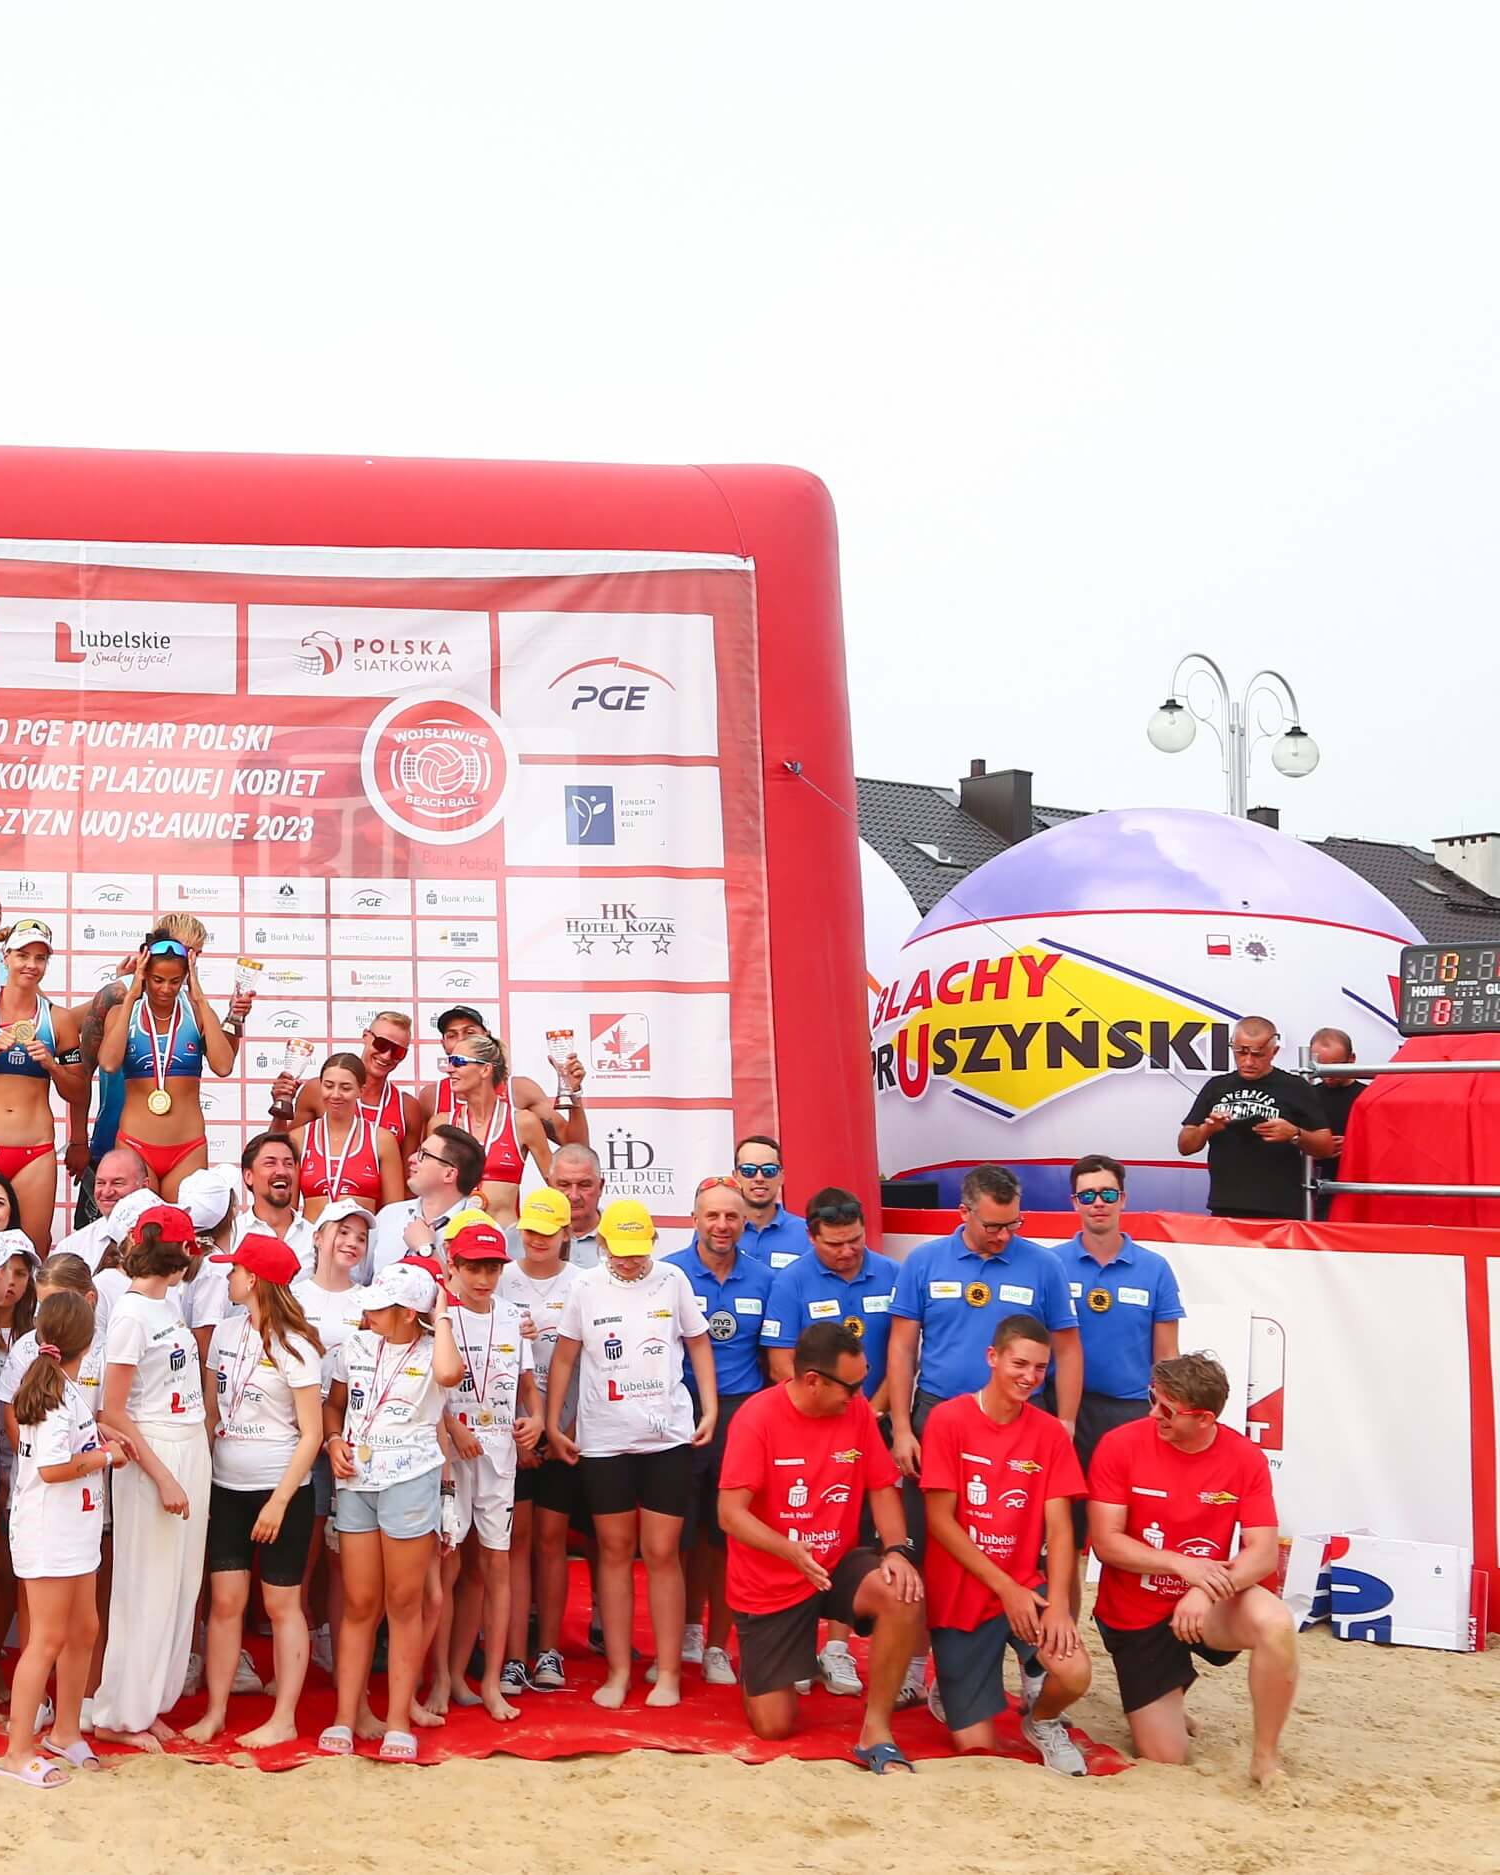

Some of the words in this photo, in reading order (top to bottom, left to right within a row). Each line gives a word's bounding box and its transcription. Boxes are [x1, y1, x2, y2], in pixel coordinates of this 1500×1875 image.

[79, 630, 171, 649] lubelskie
[353, 638, 452, 655] POLSKA
[92, 651, 135, 672] Smakuj
[353, 657, 453, 672] SIATKÓWKA
[571, 686, 650, 711] PGE
[13, 718, 67, 748] PGE
[68, 720, 176, 750] PUCHAR
[181, 722, 273, 752] POLSKI
[393, 728, 489, 748] WOJSŁAWICE
[88, 759, 225, 801] PLAŻOWEJ
[229, 768, 326, 797] KOBIET
[404, 794, 446, 807] BEACH
[448, 796, 478, 807] BALL
[79, 808, 246, 843] WOJSŁAWICE
[252, 815, 315, 842] 2023
[99, 892, 122, 902] PGE
[357, 897, 382, 907] PGE
[441, 895, 459, 903] Bank
[463, 895, 485, 903] Polski
[600, 903, 638, 920] HK
[566, 920, 618, 933] HOTEL
[626, 920, 676, 934] KOZAK
[270, 933, 289, 941] Bank
[293, 933, 315, 941] Polski
[446, 978, 472, 988] PGE
[872, 953, 1064, 1030] BLACHY
[1411, 985, 1446, 997] HOME
[274, 1019, 300, 1029] PGE
[596, 1059, 645, 1070] FAST
[601, 1171, 634, 1183] TEL
[638, 1171, 676, 1183] DUET
[603, 1184, 676, 1196] TAURACJA
[642, 1345, 664, 1356] PGE
[494, 1381, 515, 1391] PGE
[384, 1406, 411, 1416] PGE
[825, 1492, 849, 1503] PGE
[801, 1529, 840, 1542] lubels
[980, 1532, 1017, 1545] lubels
[1183, 1546, 1213, 1556] PGE
